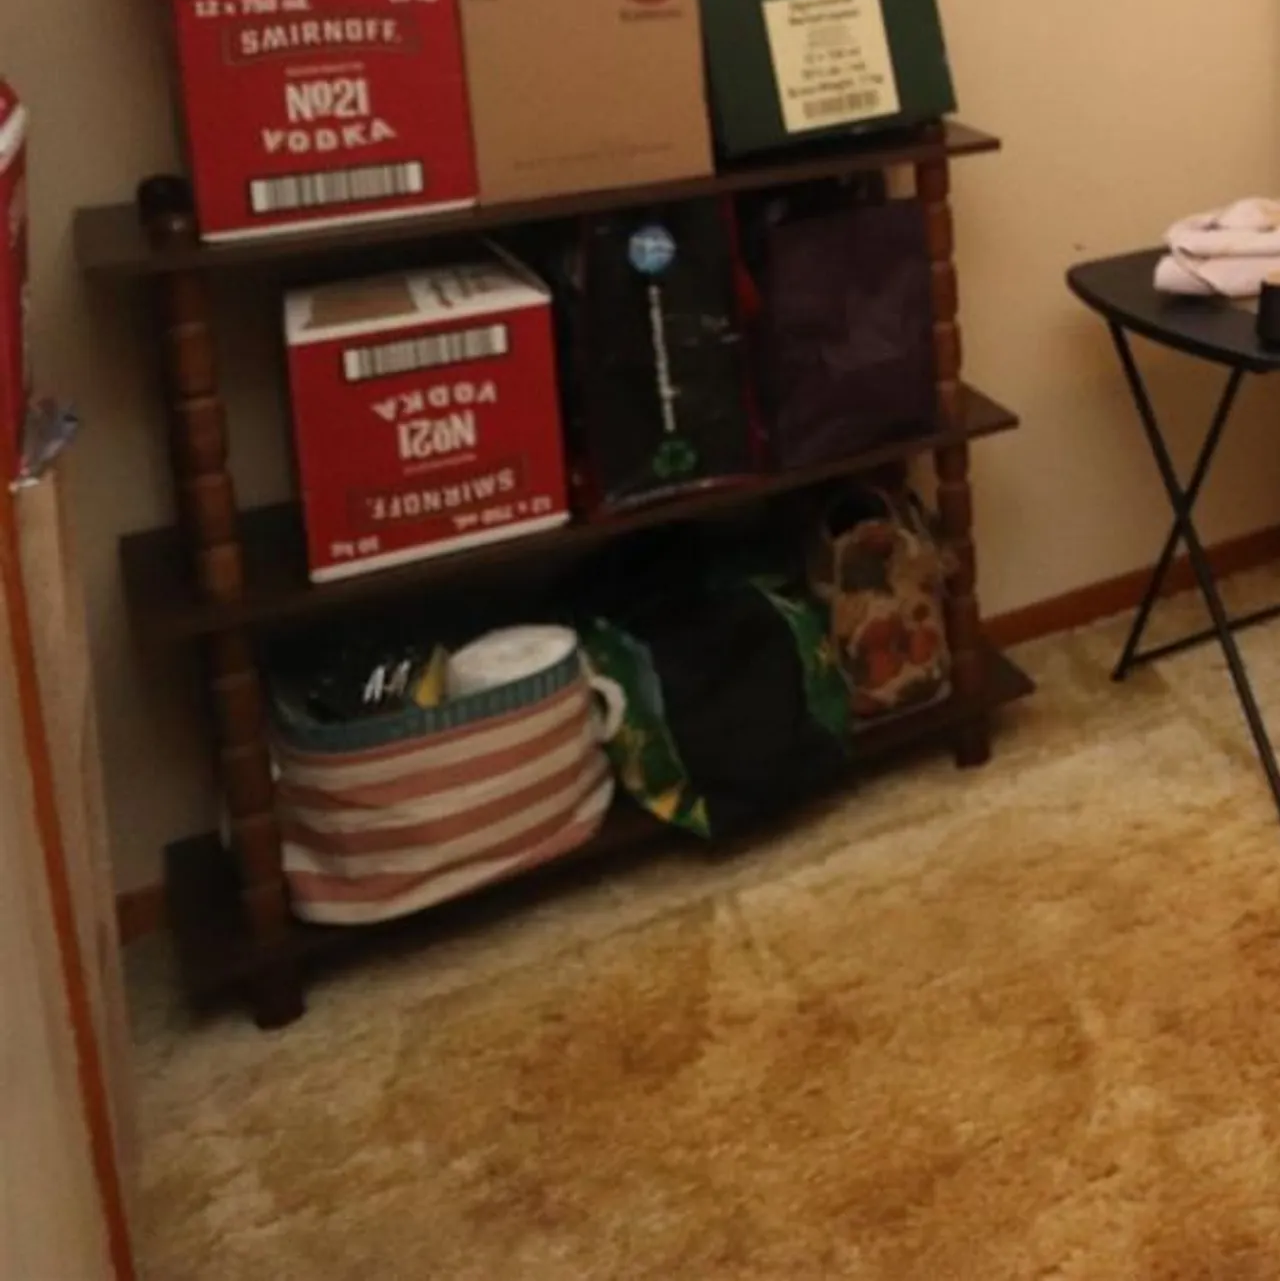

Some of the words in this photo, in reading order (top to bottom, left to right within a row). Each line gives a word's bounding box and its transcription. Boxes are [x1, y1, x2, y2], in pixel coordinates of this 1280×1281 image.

[241, 17, 400, 54] SMIRNOFF
[261, 118, 397, 154] VODKA
[371, 382, 497, 421] VODKA
[370, 468, 514, 521] SMIRNOFF
